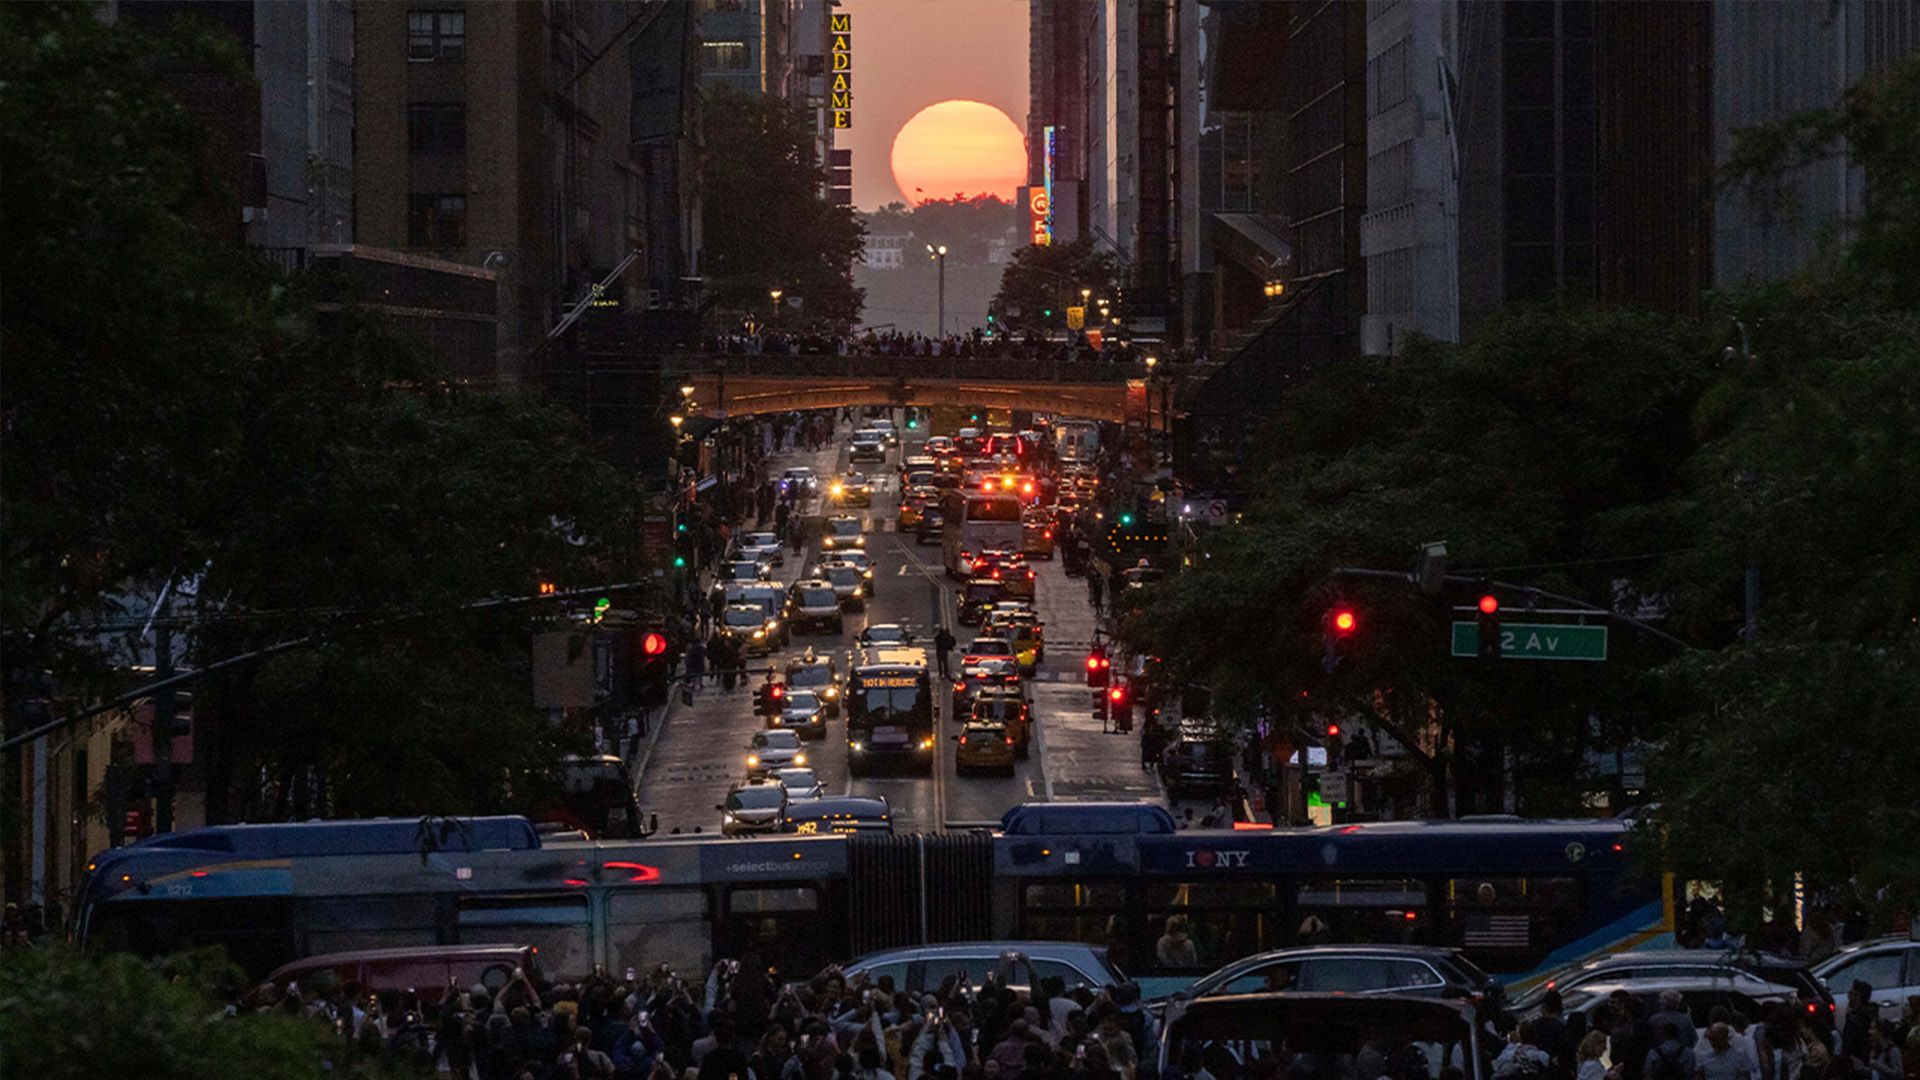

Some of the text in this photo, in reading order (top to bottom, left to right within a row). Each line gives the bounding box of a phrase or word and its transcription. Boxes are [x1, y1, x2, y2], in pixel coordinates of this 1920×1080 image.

[831, 16, 849, 128] MADAME
[1501, 631, 1559, 651] 2 Av
[1215, 851, 1250, 868] NY
